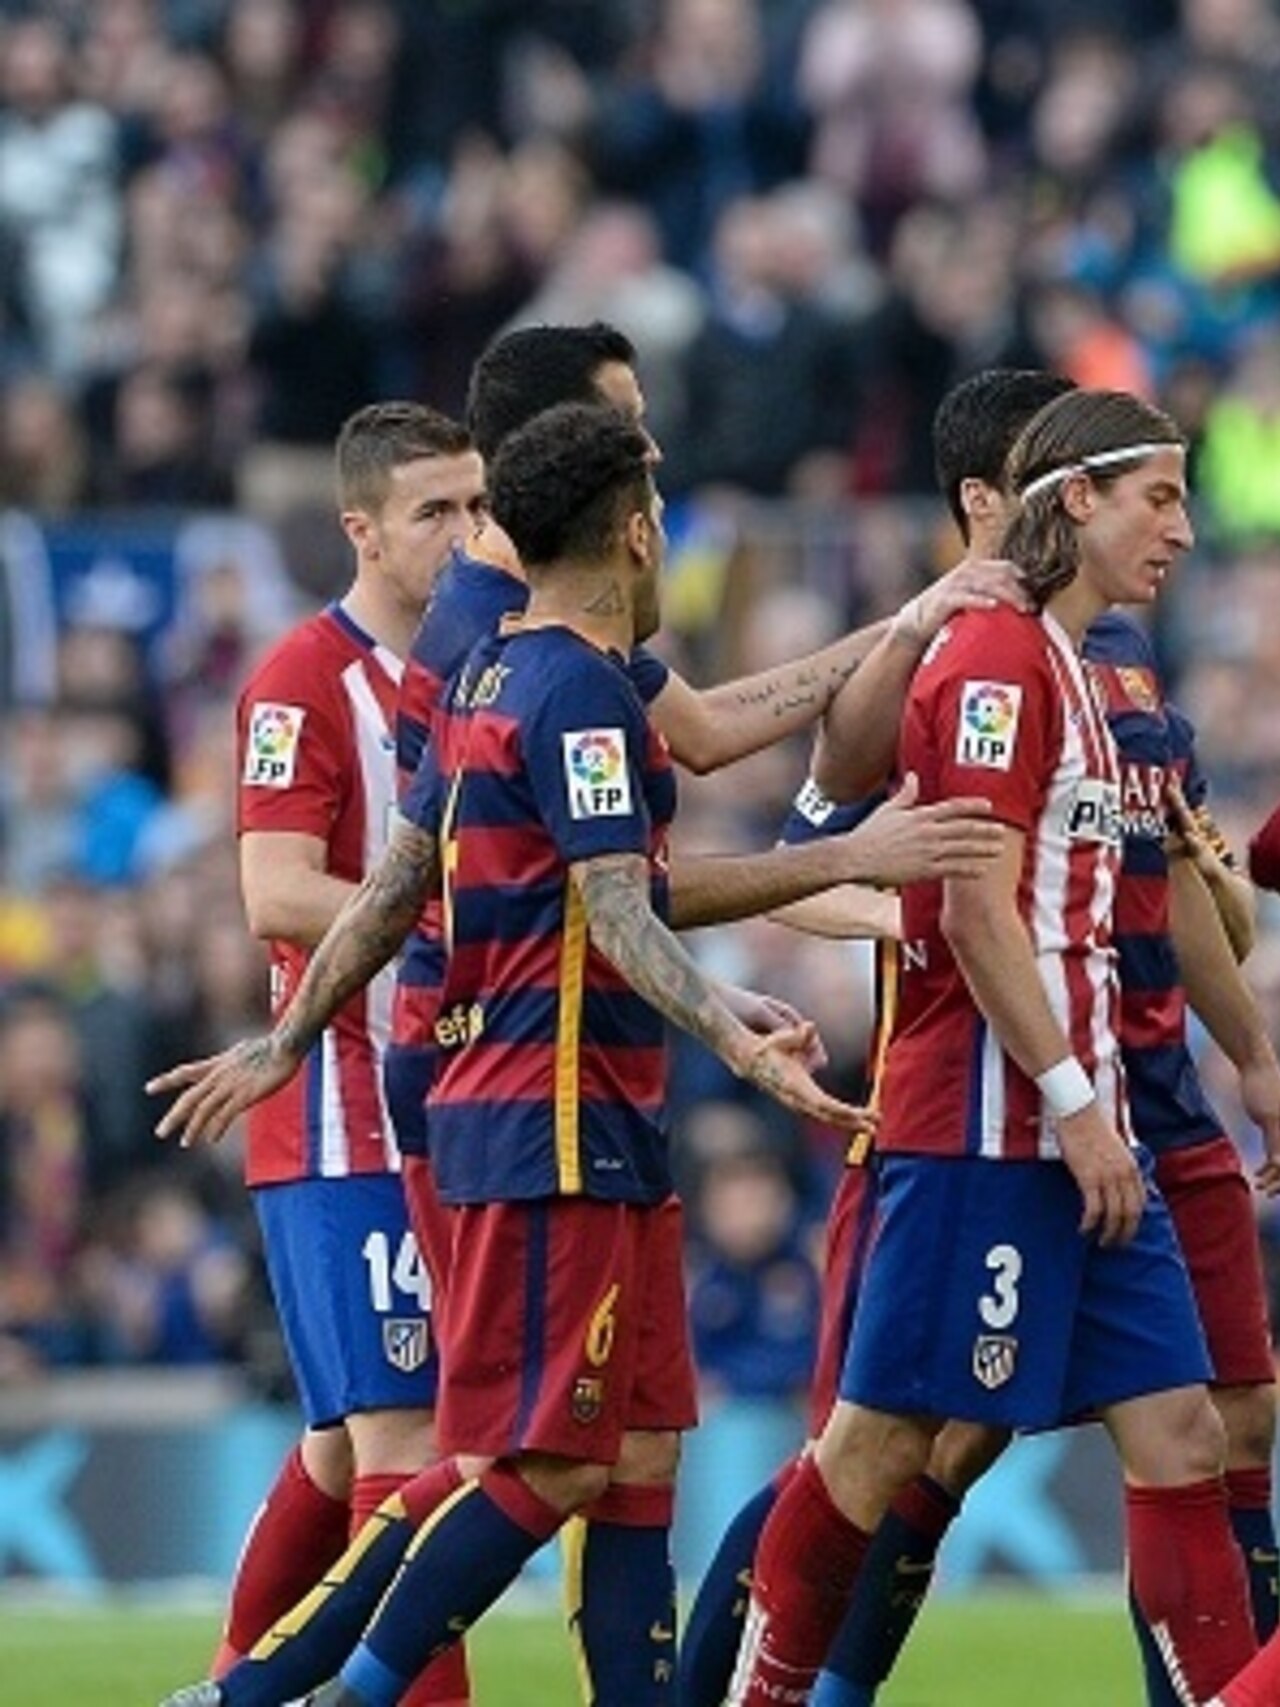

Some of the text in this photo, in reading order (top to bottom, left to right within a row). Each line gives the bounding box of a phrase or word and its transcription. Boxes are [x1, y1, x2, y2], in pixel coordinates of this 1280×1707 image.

[963, 736, 1006, 764] LFP
[576, 788, 622, 815] LFP
[361, 1231, 432, 1312] 14
[978, 1244, 1022, 1328] 3
[586, 1283, 621, 1367] 6
